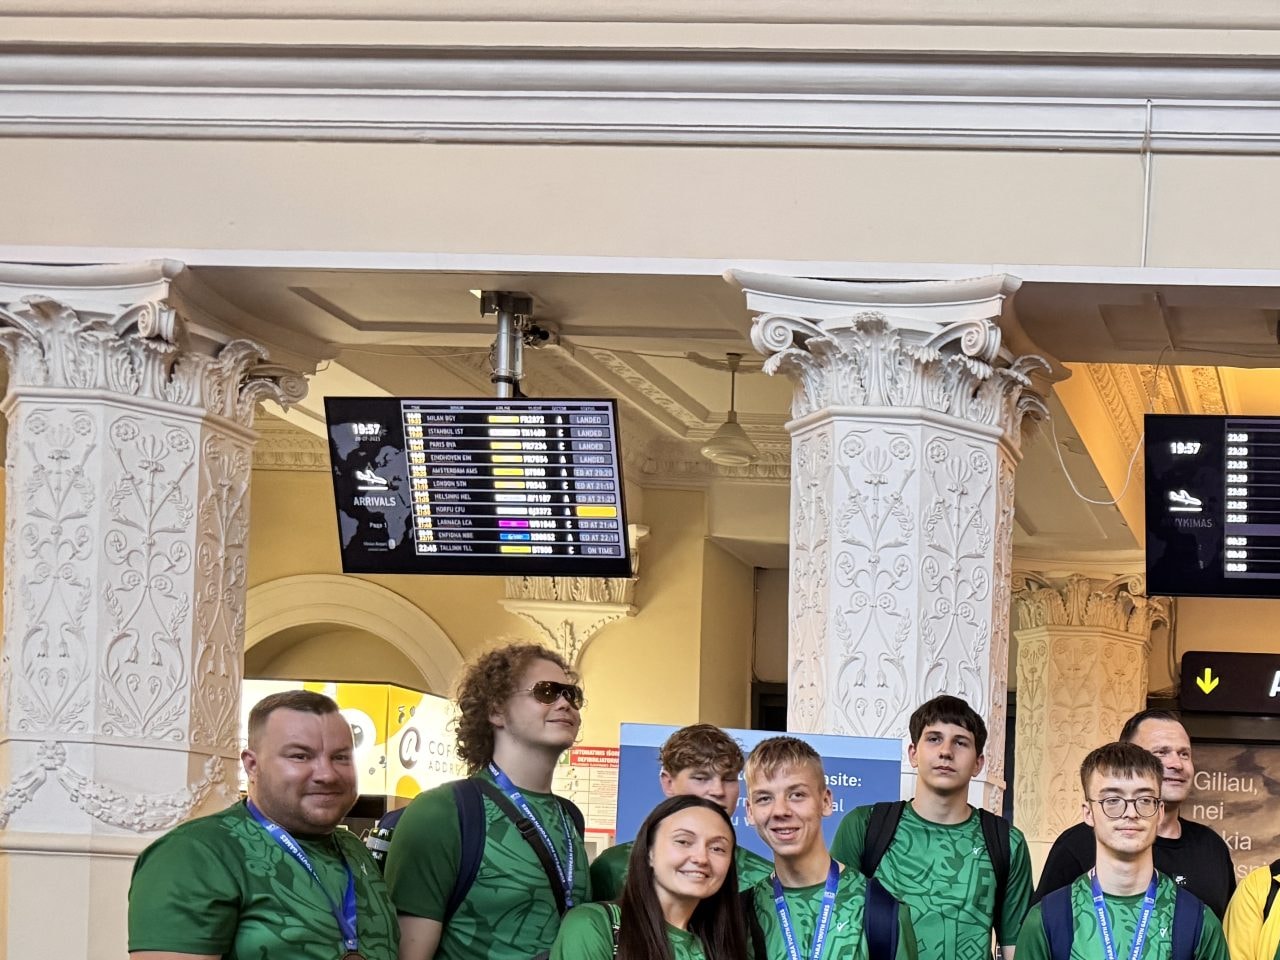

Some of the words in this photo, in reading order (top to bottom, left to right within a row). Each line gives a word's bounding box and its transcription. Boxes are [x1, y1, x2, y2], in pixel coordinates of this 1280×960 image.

[1170, 441, 1201, 455] 19:57
[353, 496, 397, 507] ARRIVALS
[1193, 771, 1258, 796] Giliau,
[521, 803, 536, 820] GAMES
[1192, 801, 1224, 820] nei
[534, 820, 547, 839] YOUTH
[280, 834, 298, 854] GAMES
[1222, 830, 1252, 851] kia
[780, 909, 789, 928] GAMES
[1098, 907, 1107, 926] GAMES
[1140, 909, 1150, 928] GAMES
[785, 927, 793, 946] YOUTH
[813, 943, 821, 958] PARA
[817, 923, 825, 943] YOUTH
[821, 904, 830, 924] GAMES
[1102, 926, 1111, 945] YOUTH
[1136, 927, 1145, 946] YOUTH
[789, 945, 798, 960] PARA
[1106, 945, 1115, 960] PARA
[1131, 946, 1140, 960] PARA
